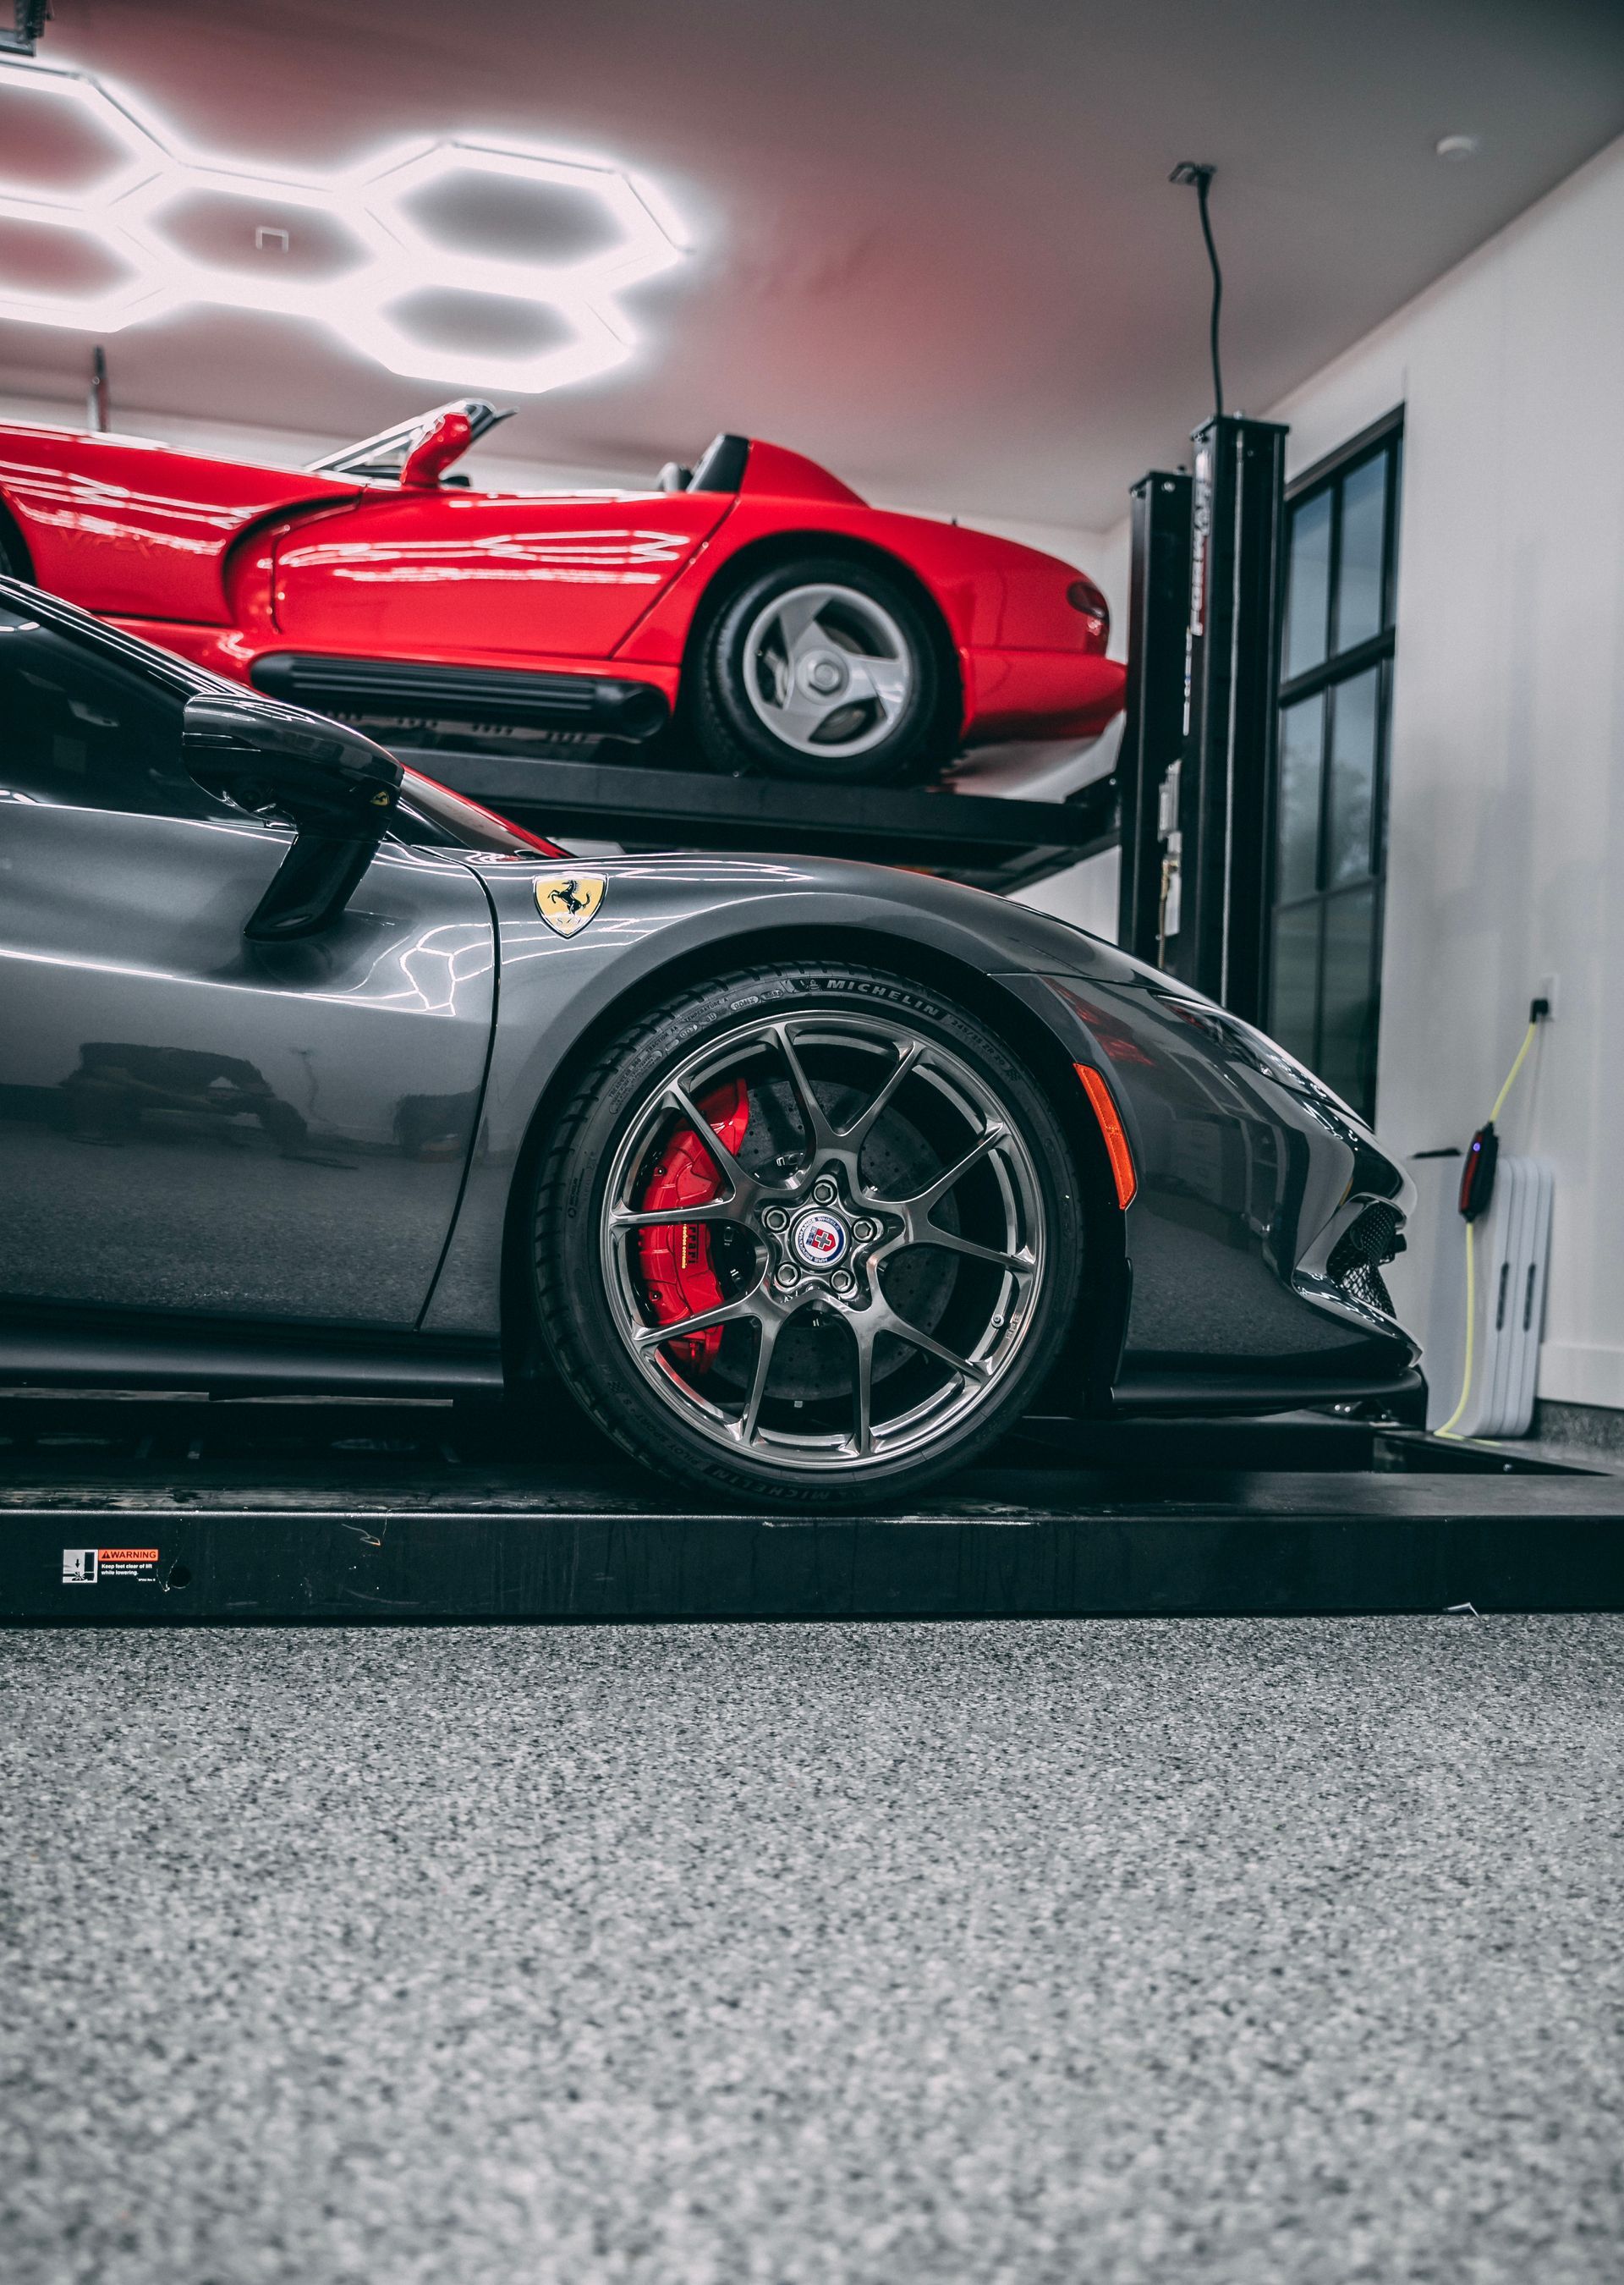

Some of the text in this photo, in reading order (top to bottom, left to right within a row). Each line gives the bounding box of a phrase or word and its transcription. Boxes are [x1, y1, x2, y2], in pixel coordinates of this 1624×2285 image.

[826, 980, 940, 1016] MICHELIN
[645, 1032, 669, 1053] TRACTION
[683, 999, 722, 1022] TEMPERATURE
[668, 1442, 700, 1466] PILOT
[712, 1469, 830, 1500] MICHELIN
